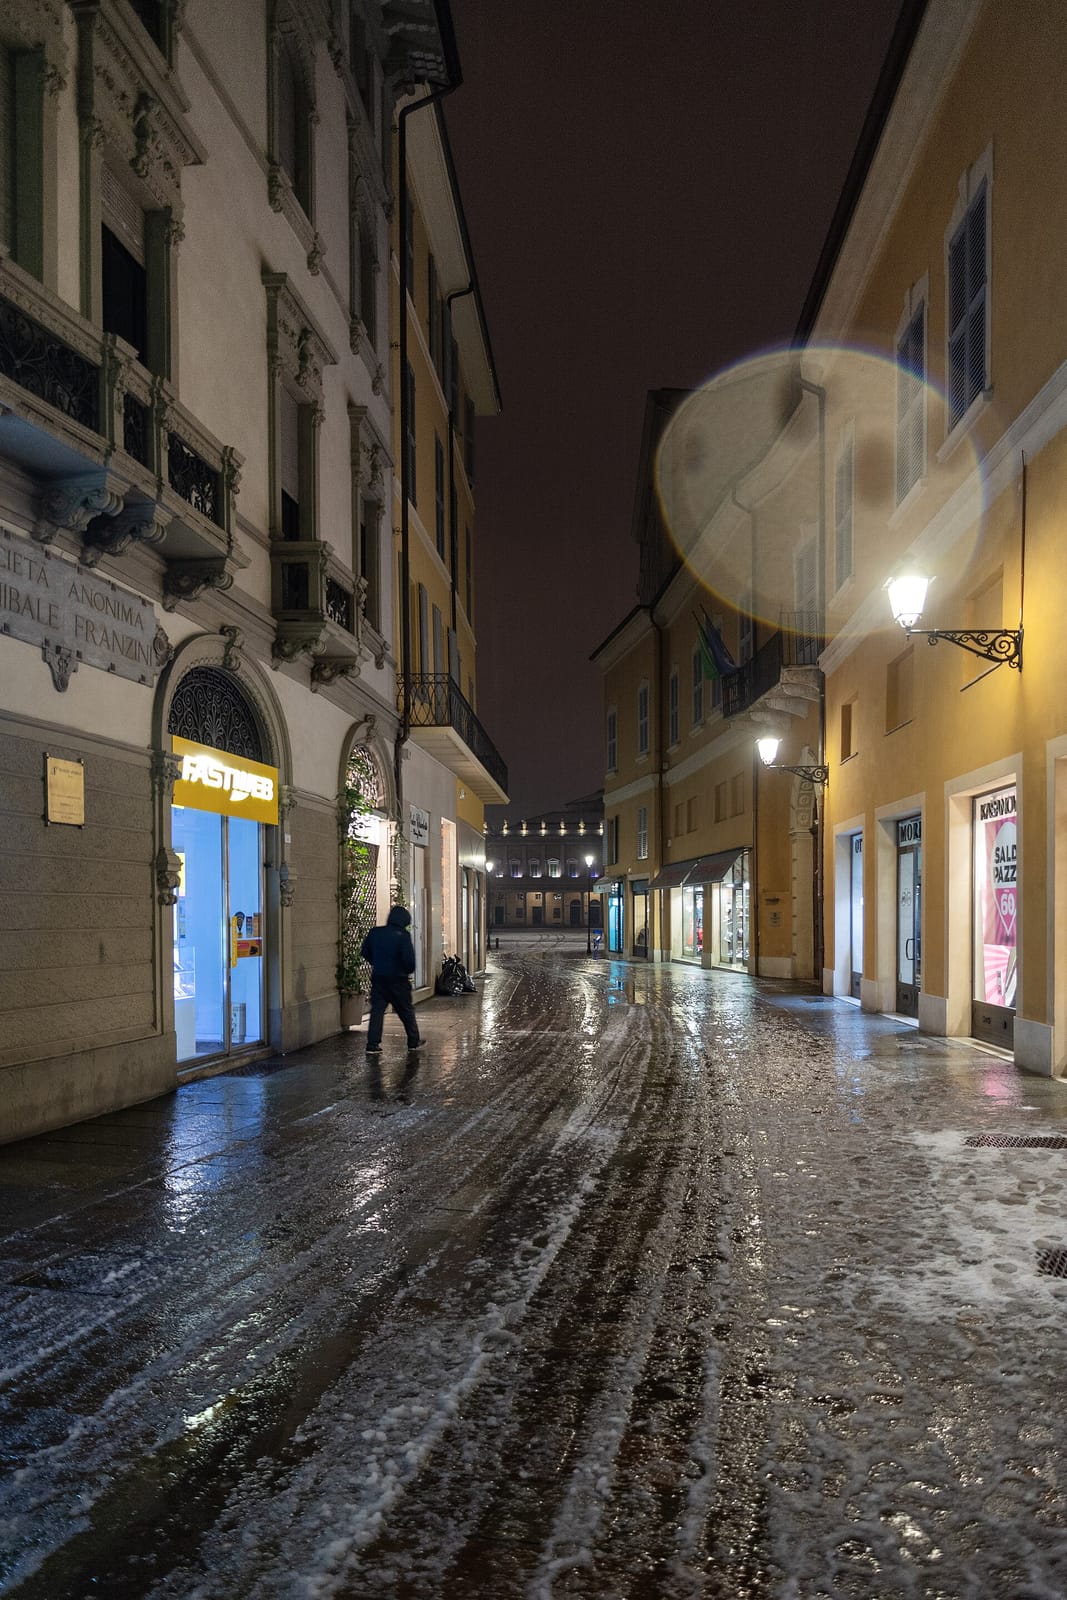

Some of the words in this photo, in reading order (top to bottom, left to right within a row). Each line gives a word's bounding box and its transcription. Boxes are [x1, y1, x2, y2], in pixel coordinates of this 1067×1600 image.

[0, 582, 60, 630] IBALE
[74, 614, 153, 667] FRANZINI
[67, 581, 144, 631] ANONIMA
